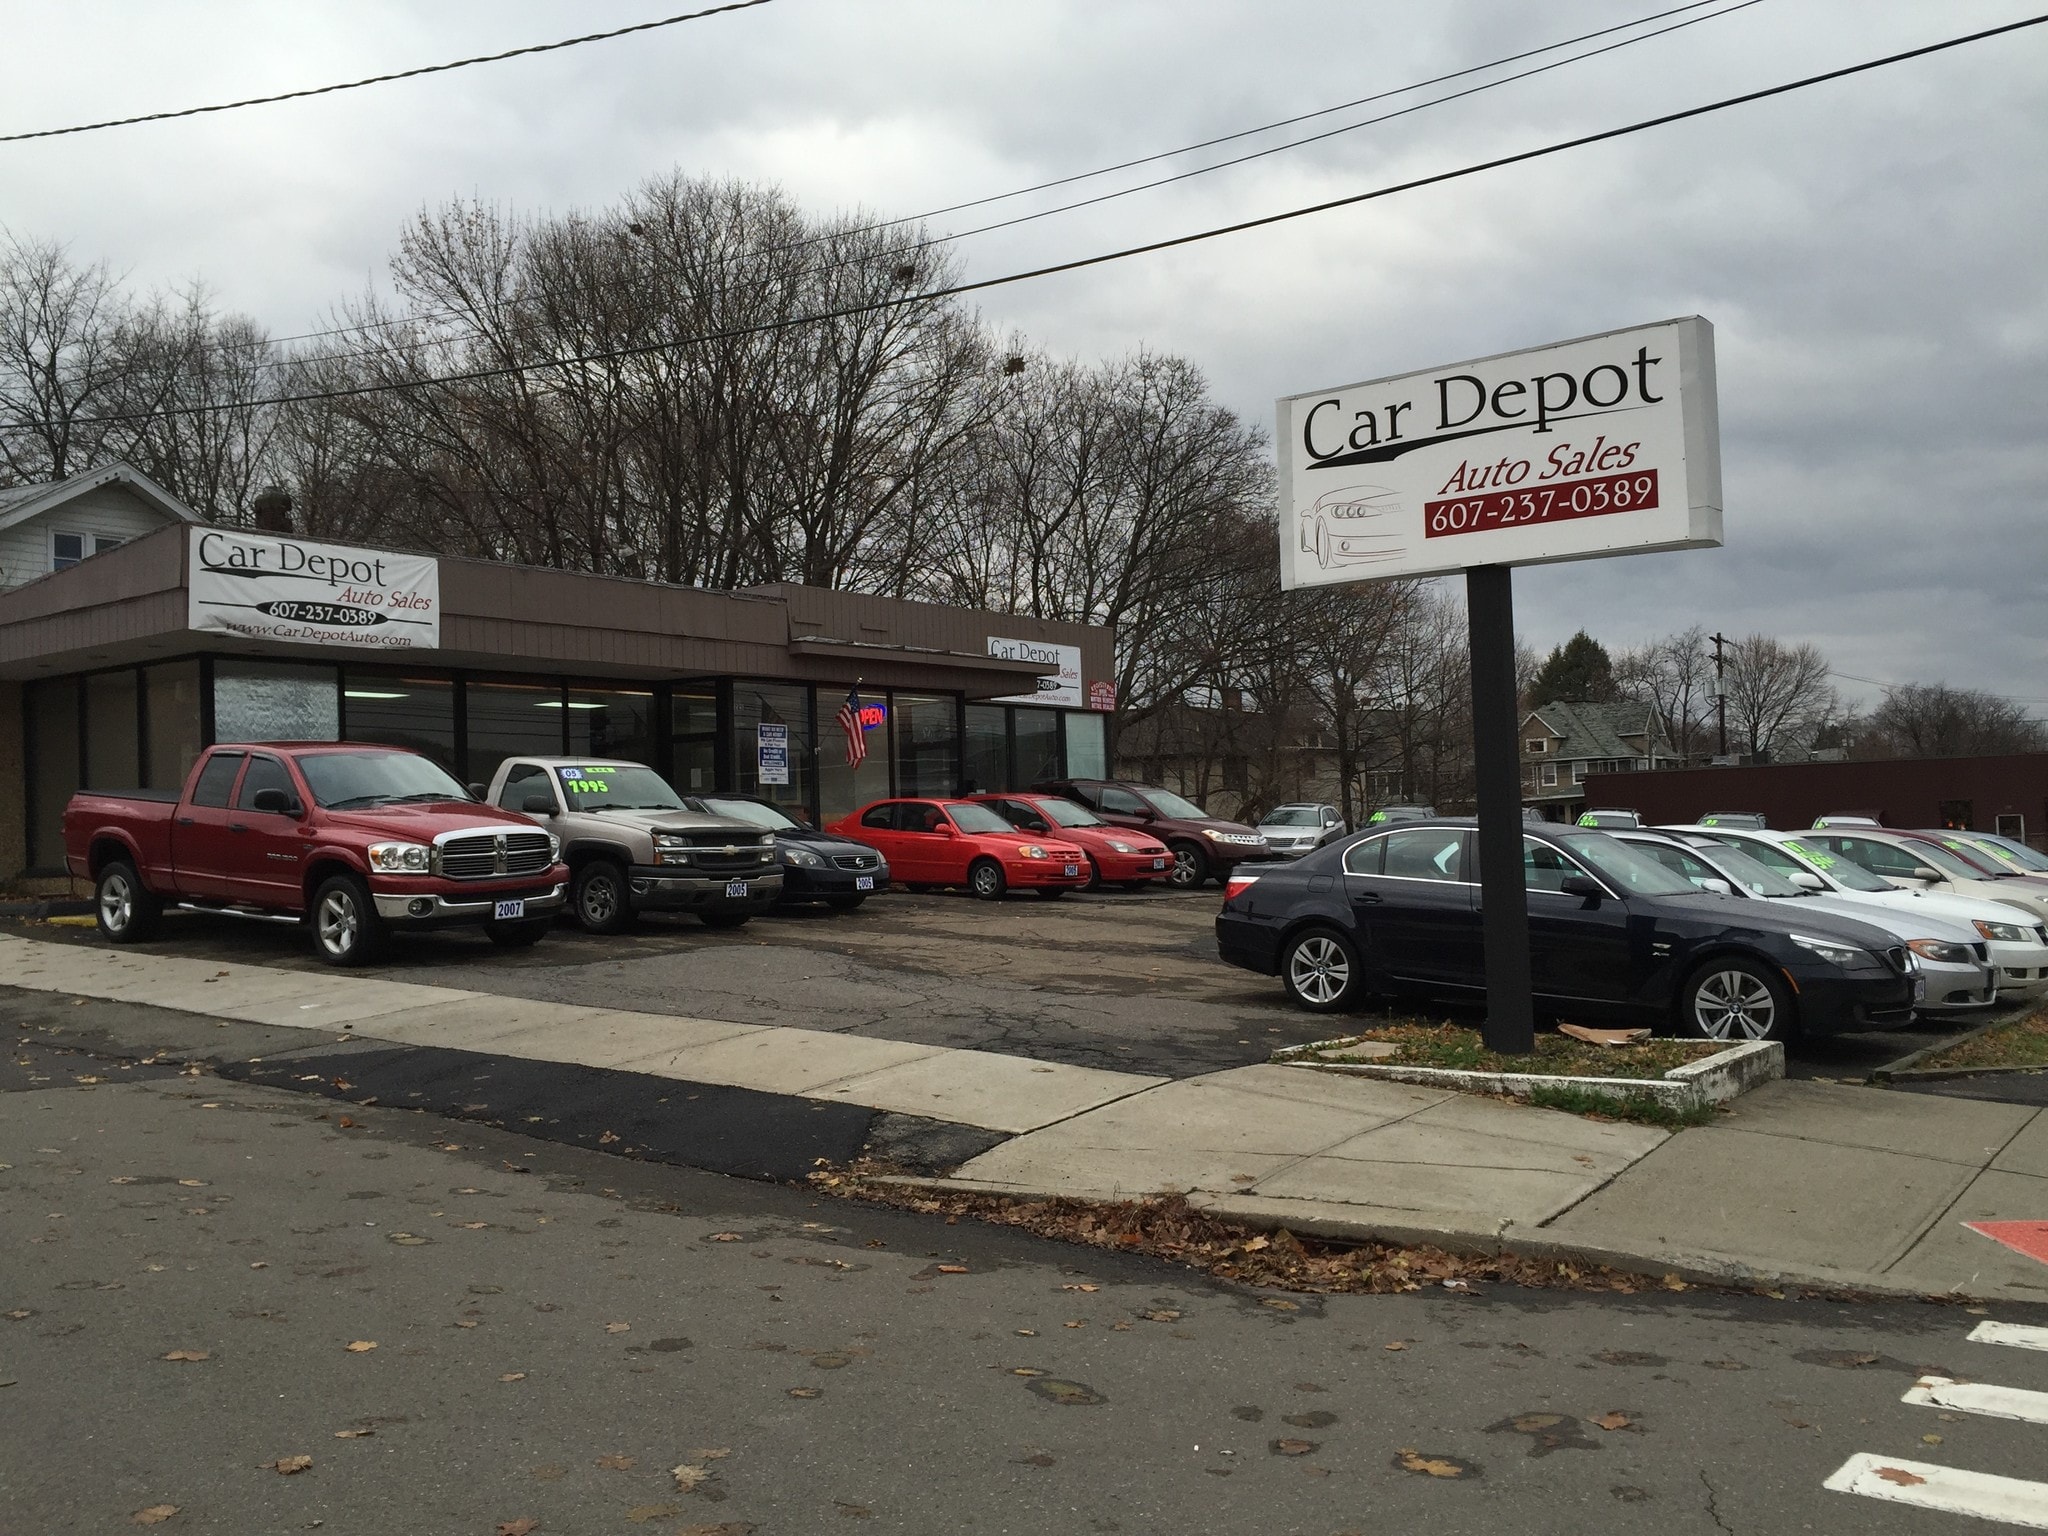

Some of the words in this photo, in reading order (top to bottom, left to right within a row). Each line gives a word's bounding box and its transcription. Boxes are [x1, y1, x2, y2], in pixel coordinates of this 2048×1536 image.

[1304, 399, 1411, 461] Car
[1434, 346, 1664, 434] Depot
[1438, 456, 1530, 496] Auto
[1539, 436, 1640, 480] Sales
[1431, 476, 1653, 532] 607-237-0389
[199, 533, 265, 568] Car
[278, 543, 387, 587] Depot
[336, 586, 383, 606] Auto
[388, 590, 432, 610] Sales
[269, 602, 376, 625] 607-237-0389
[226, 622, 411, 647] www.CarDepotAuto.com
[991, 640, 1015, 659] Car
[1019, 643, 1060, 665] Depot
[1060, 668, 1078, 680] Sales
[568, 780, 608, 793] 7995
[728, 884, 745, 896] 2005
[498, 903, 521, 917] 2007
